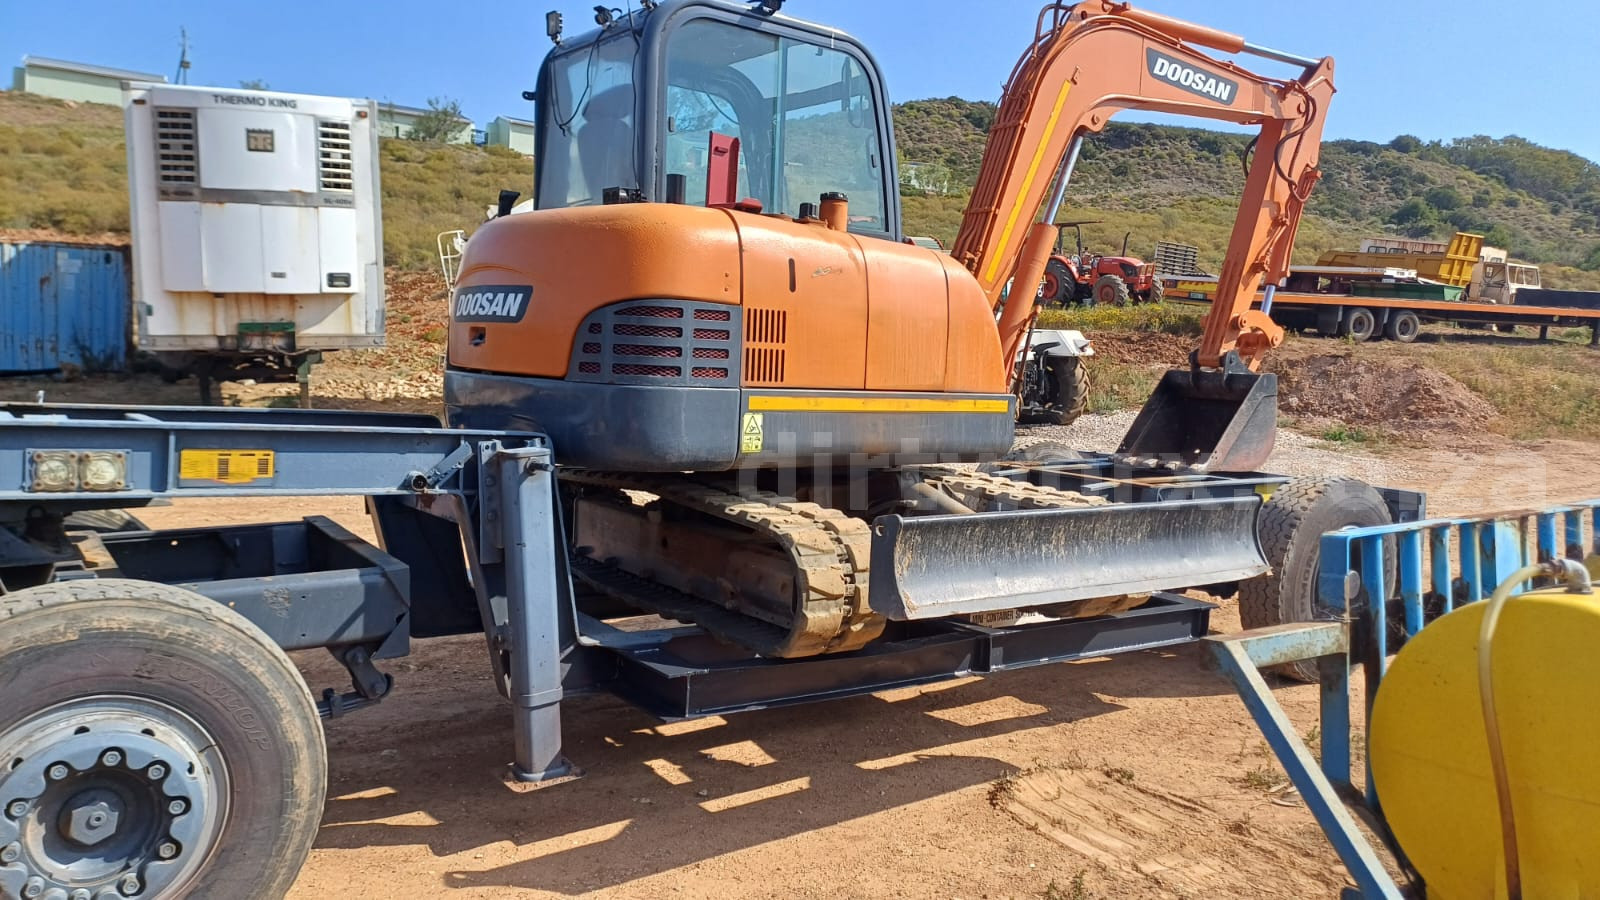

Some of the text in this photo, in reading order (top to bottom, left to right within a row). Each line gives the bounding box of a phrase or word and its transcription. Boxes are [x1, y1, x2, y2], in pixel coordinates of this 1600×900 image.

[1153, 57, 1231, 101] DOOSAN
[211, 94, 297, 109] THERMO KING
[456, 292, 524, 317] DOOSAN
